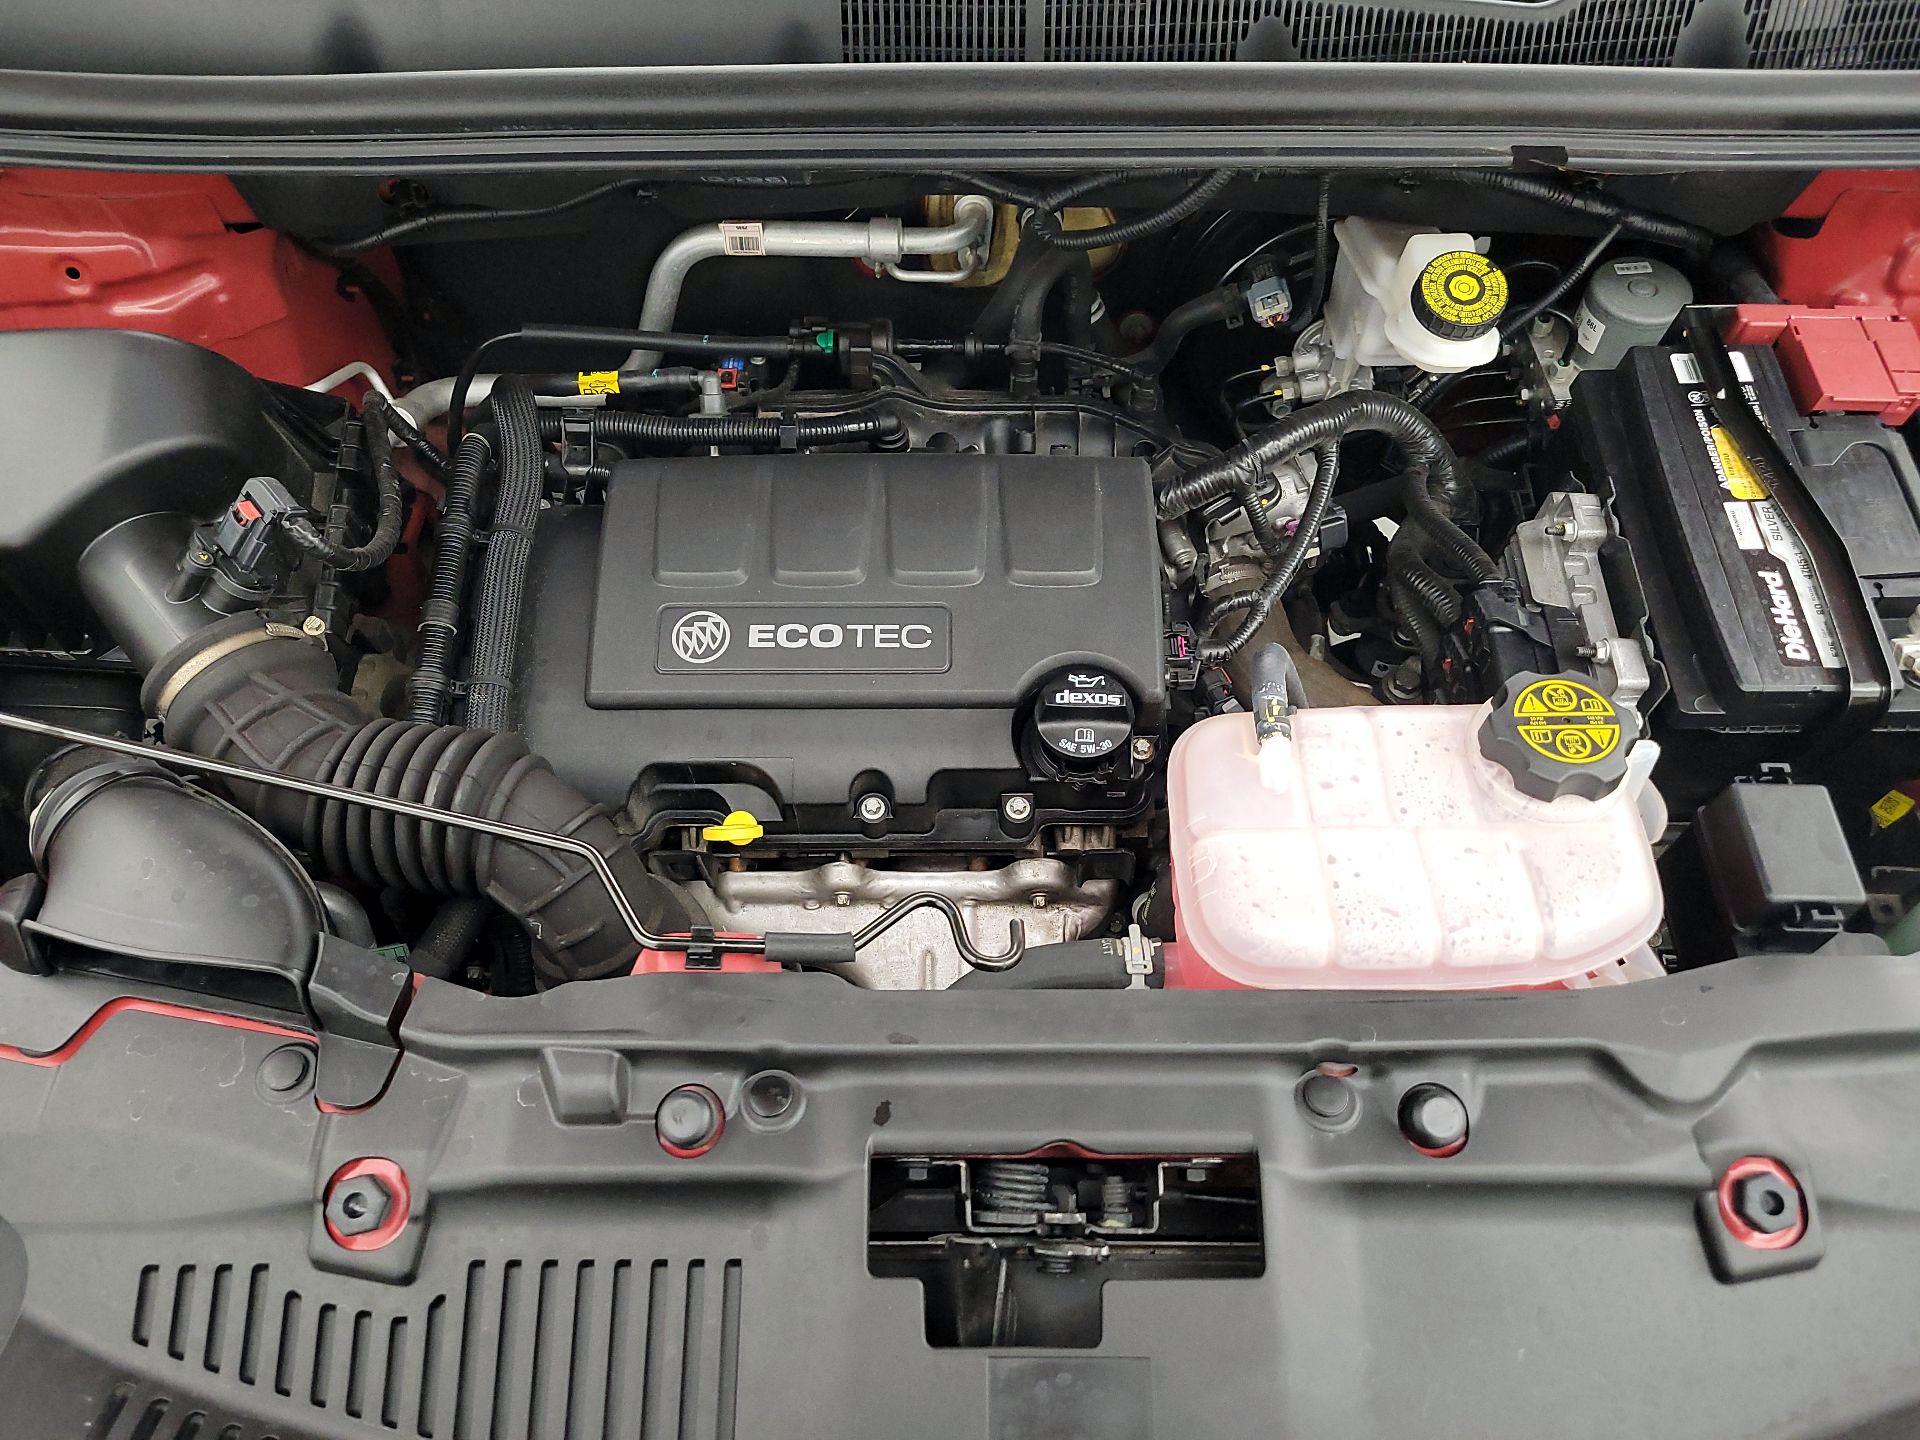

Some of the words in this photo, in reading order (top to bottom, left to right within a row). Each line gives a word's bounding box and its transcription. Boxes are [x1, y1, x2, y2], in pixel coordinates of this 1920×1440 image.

[1762, 506, 1783, 541] SILVER
[1757, 570, 1810, 661] DieHard
[748, 623, 933, 649] ECOTEC
[1055, 689, 1123, 706] dexos
[1058, 738, 1077, 753] SAE
[1080, 739, 1113, 754] 5W-30
